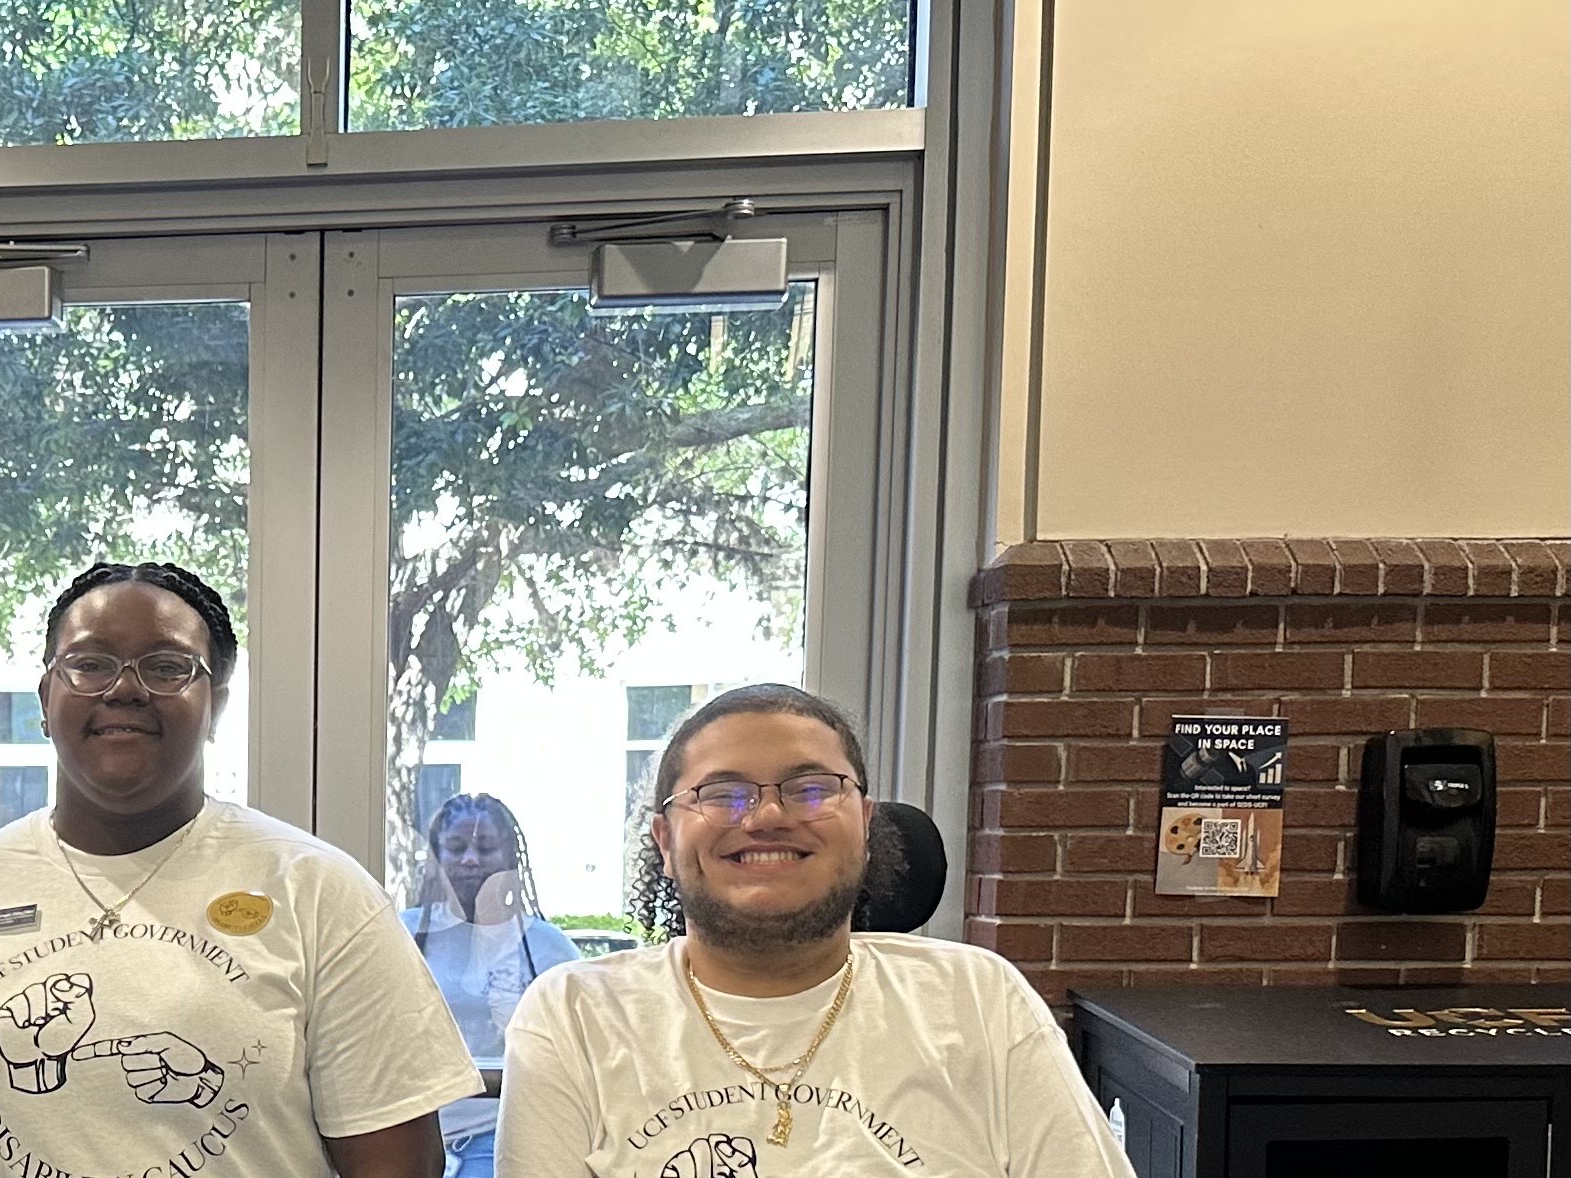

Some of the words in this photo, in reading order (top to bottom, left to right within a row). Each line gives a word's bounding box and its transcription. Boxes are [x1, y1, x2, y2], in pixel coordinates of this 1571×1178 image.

[1175, 724, 1201, 734] FIND
[1205, 725, 1238, 735] YOUR
[1241, 725, 1281, 735] PLACE
[1198, 739, 1210, 749] IN
[1214, 739, 1255, 749] SPACE
[9, 928, 109, 971] STUDENT
[113, 923, 250, 985] GOVERNMENT
[627, 1109, 669, 1150] UCF
[669, 1081, 769, 1120] STUDENT
[774, 1082, 925, 1169] GOVERNMENT
